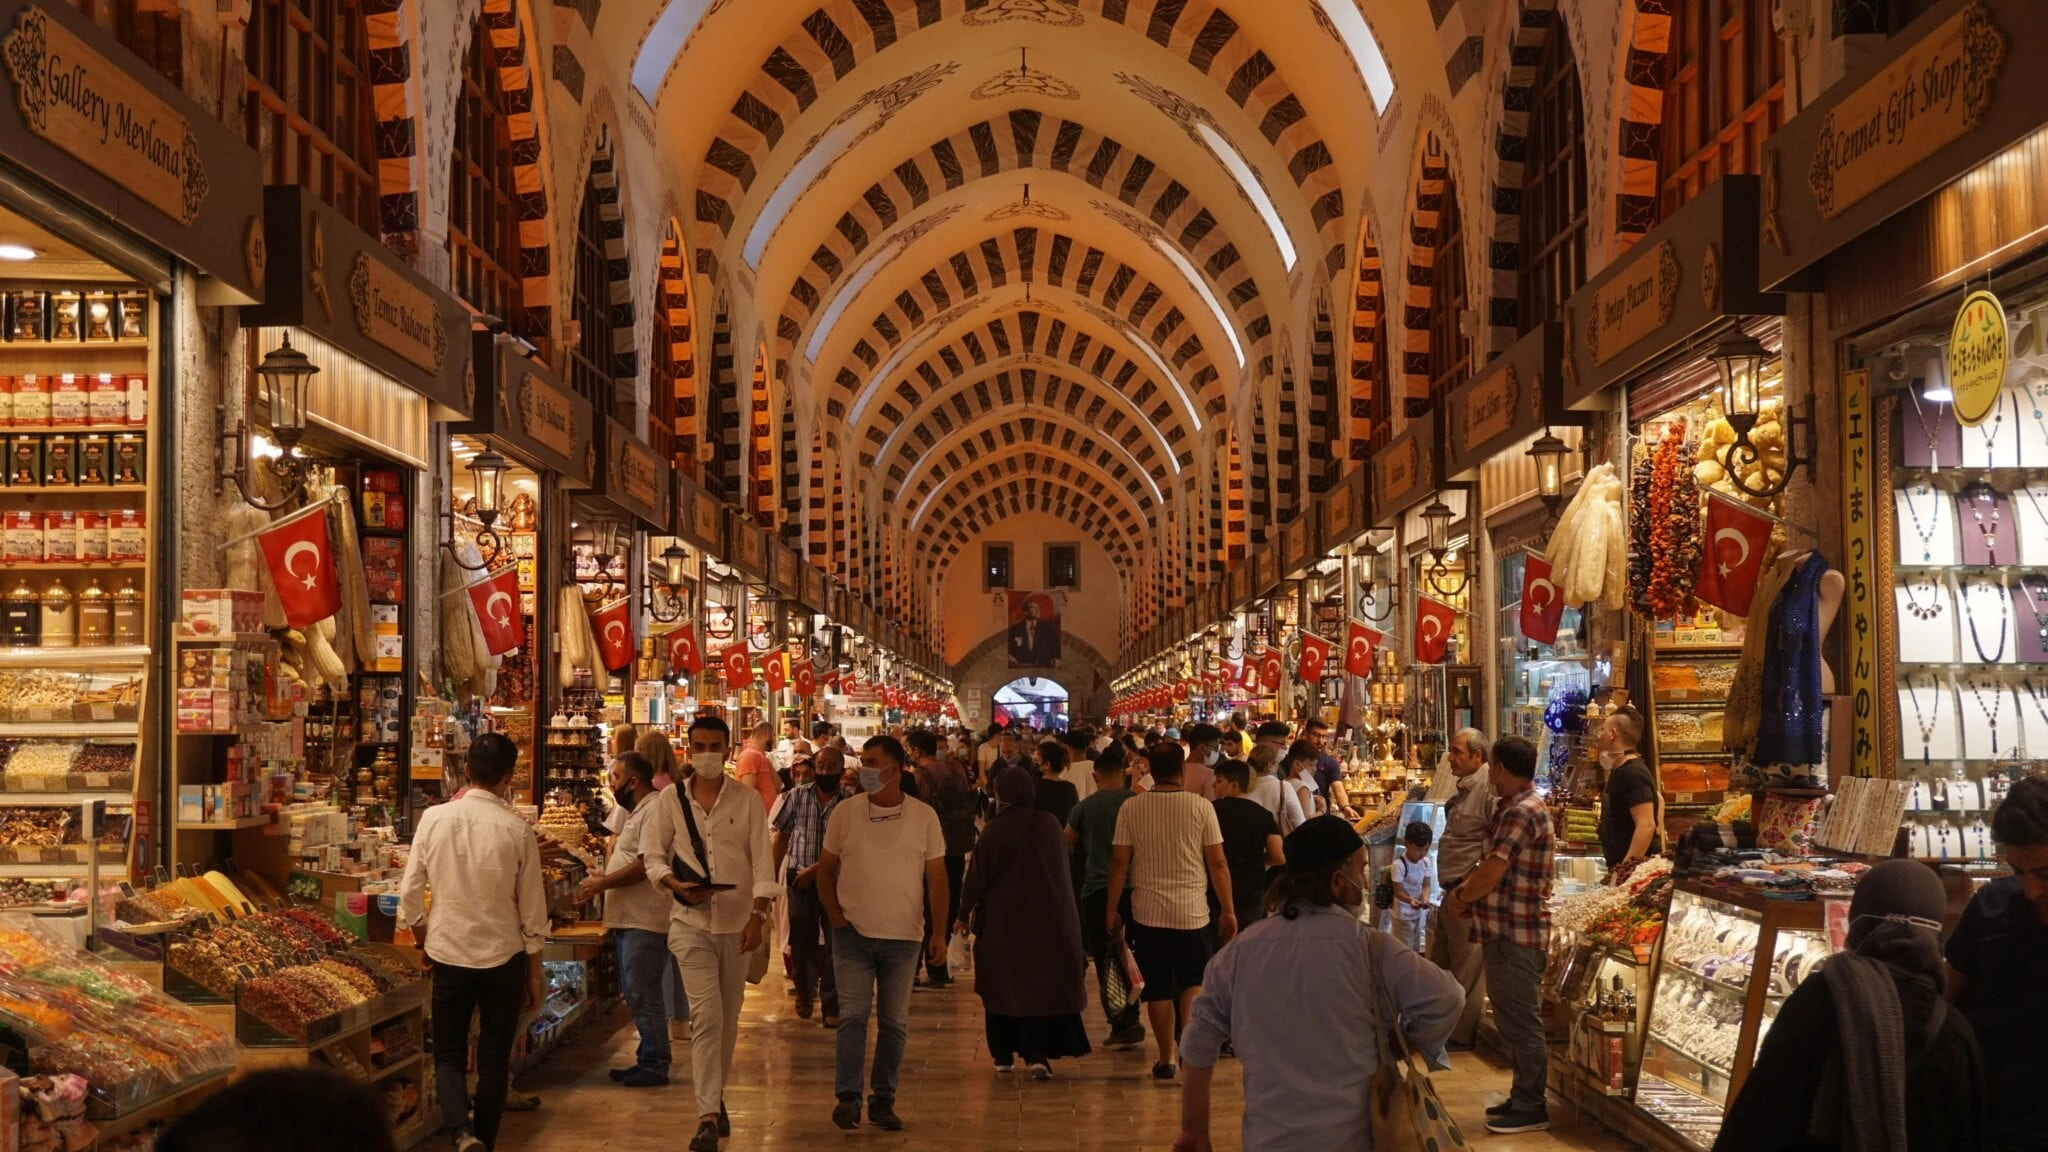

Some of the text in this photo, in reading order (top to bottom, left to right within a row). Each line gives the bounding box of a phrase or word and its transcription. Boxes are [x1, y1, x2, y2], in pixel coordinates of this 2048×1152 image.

[48, 54, 181, 179] Gallery Mevlana
[1834, 54, 1961, 171] Cennet Gift Shop
[254, 238, 263, 270] 41
[1704, 263, 1714, 292] 50
[372, 288, 431, 349] Temiz Baharat
[1603, 296, 1626, 331] Antep
